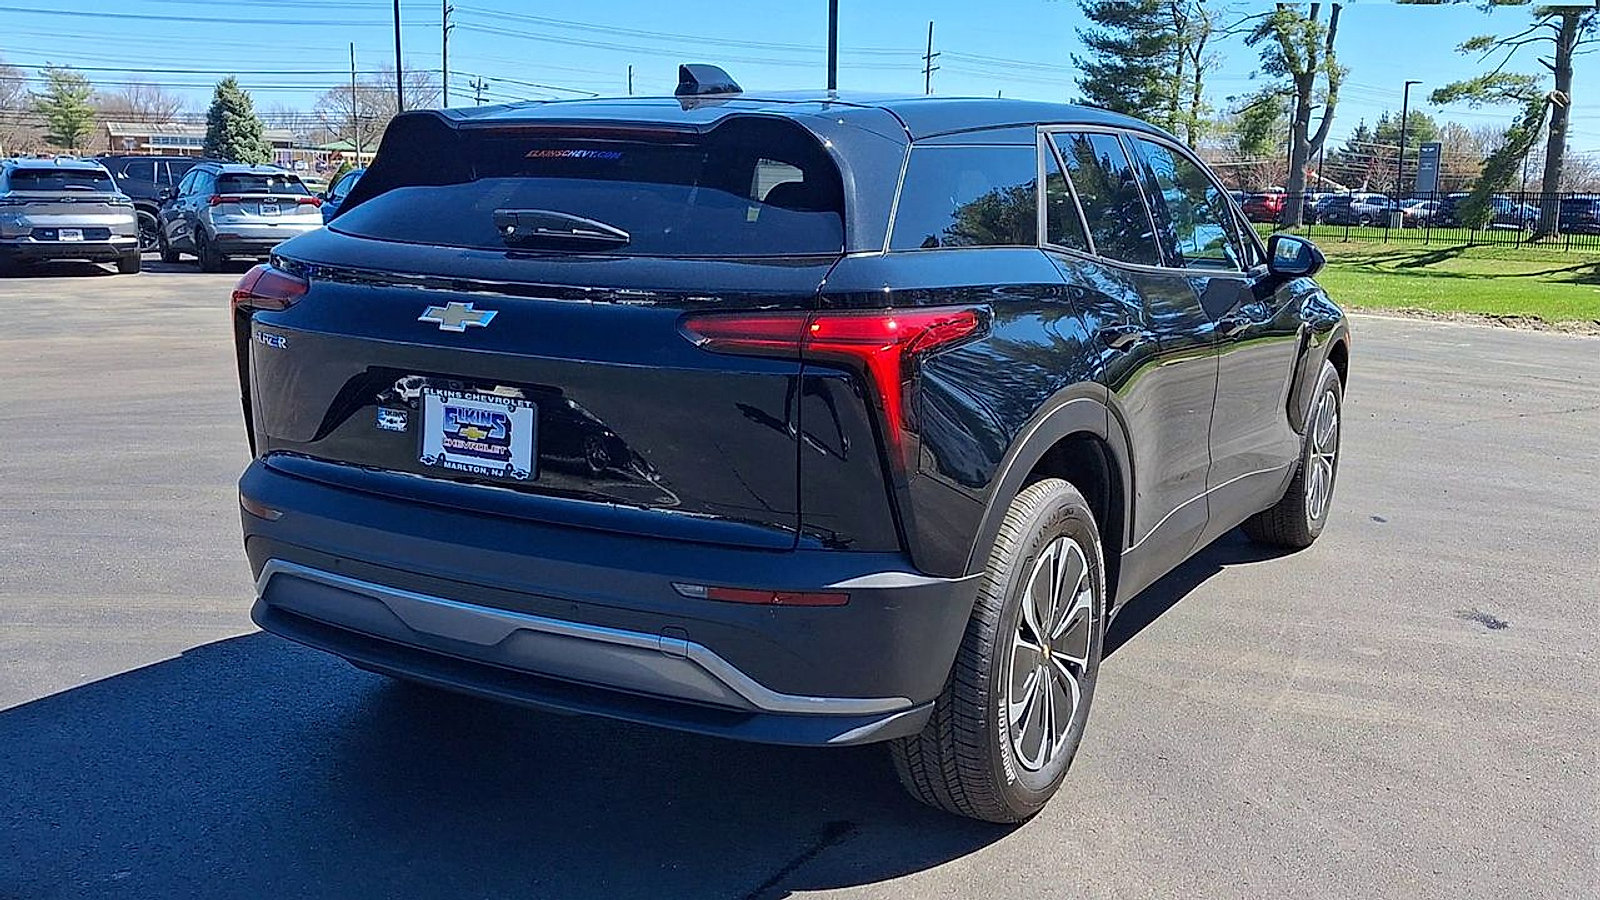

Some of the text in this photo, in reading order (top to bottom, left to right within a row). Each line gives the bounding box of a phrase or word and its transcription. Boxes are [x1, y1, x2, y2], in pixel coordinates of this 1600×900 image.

[525, 150, 621, 158] ELKINSCHEVY.COM
[424, 388, 532, 407] ELKINS CHEVROLET
[443, 406, 506, 439] ELKINS
[443, 438, 507, 454] CHEVROLET
[444, 462, 504, 477] MARLTON, NJ
